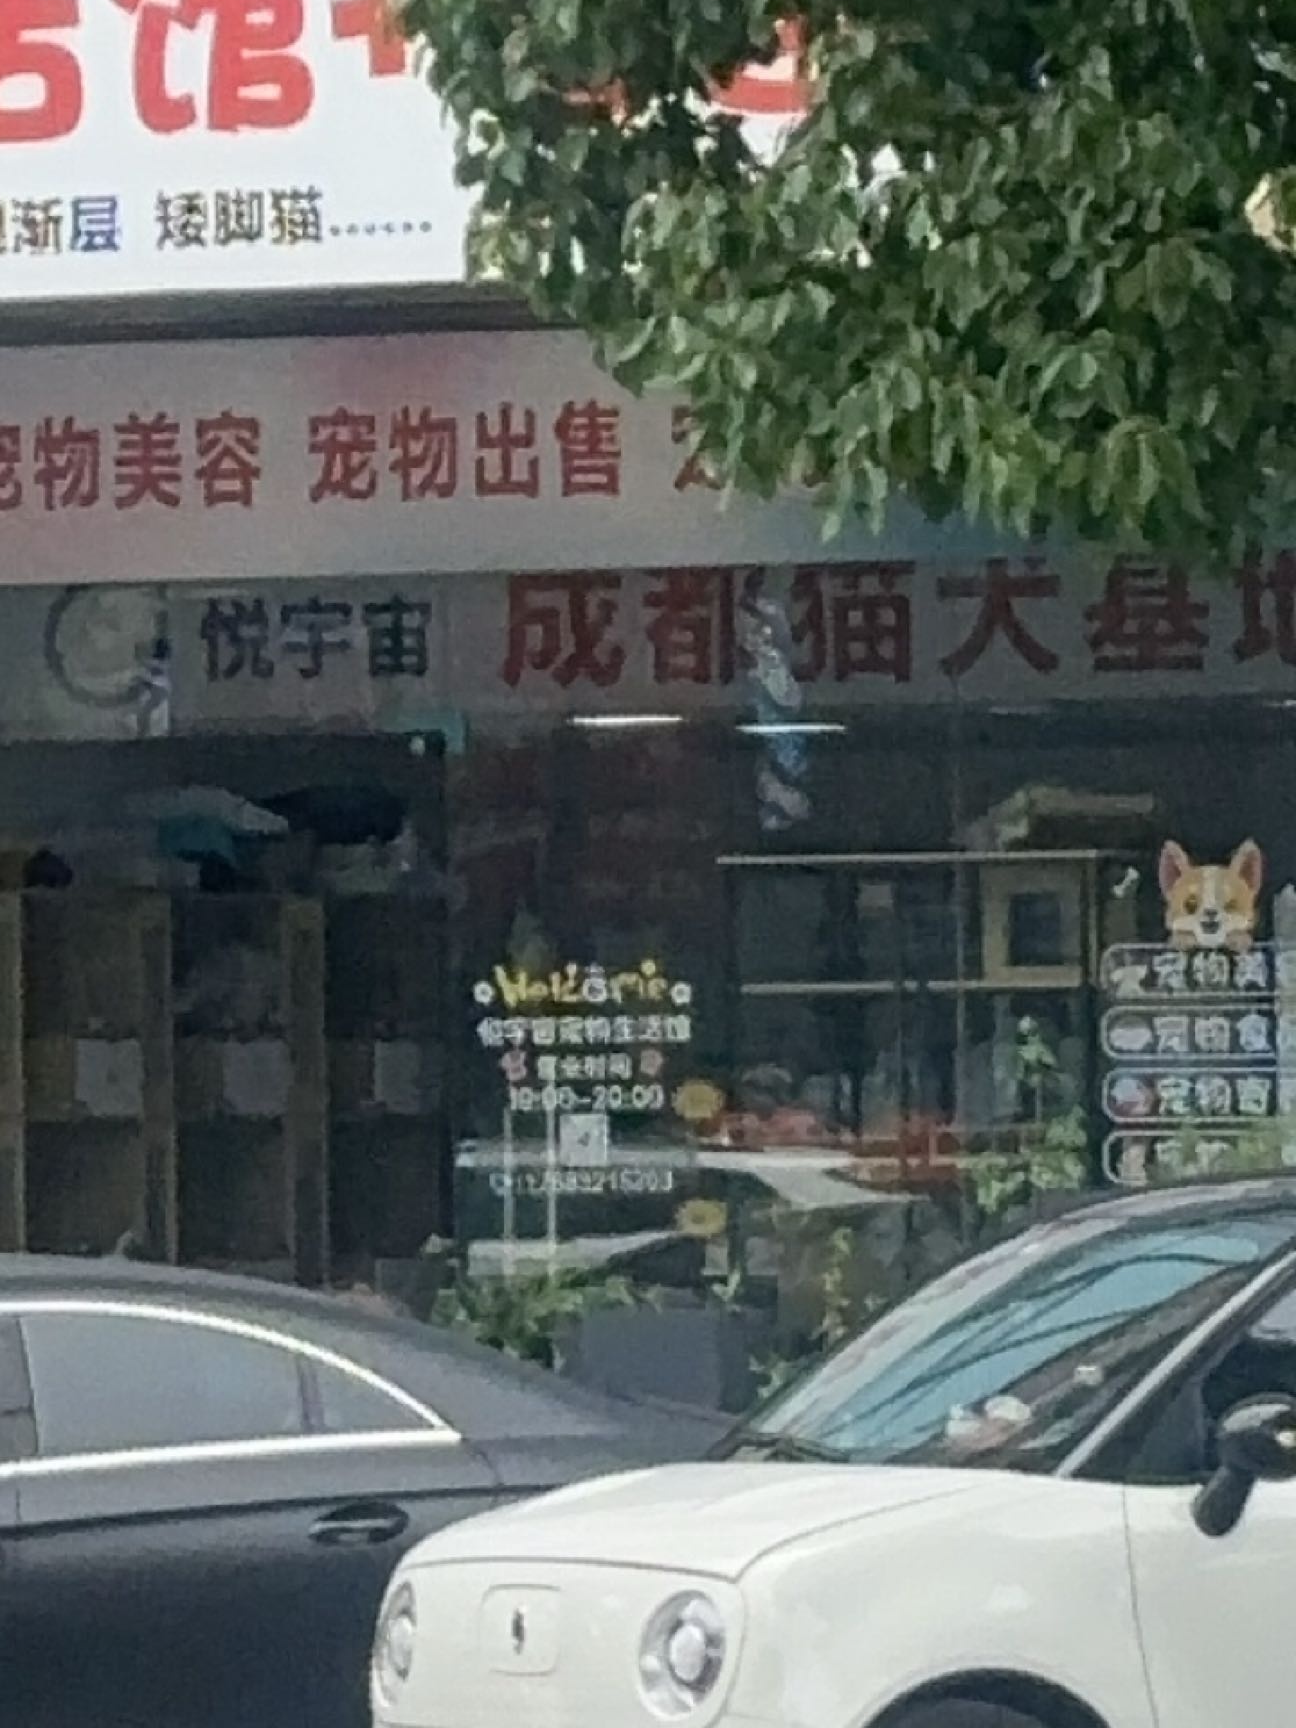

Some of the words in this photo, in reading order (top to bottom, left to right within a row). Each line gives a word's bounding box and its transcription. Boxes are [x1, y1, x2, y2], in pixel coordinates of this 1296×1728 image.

[307, 399, 622, 504] 宠物出售
[200, 593, 432, 684] 悦宇宙
